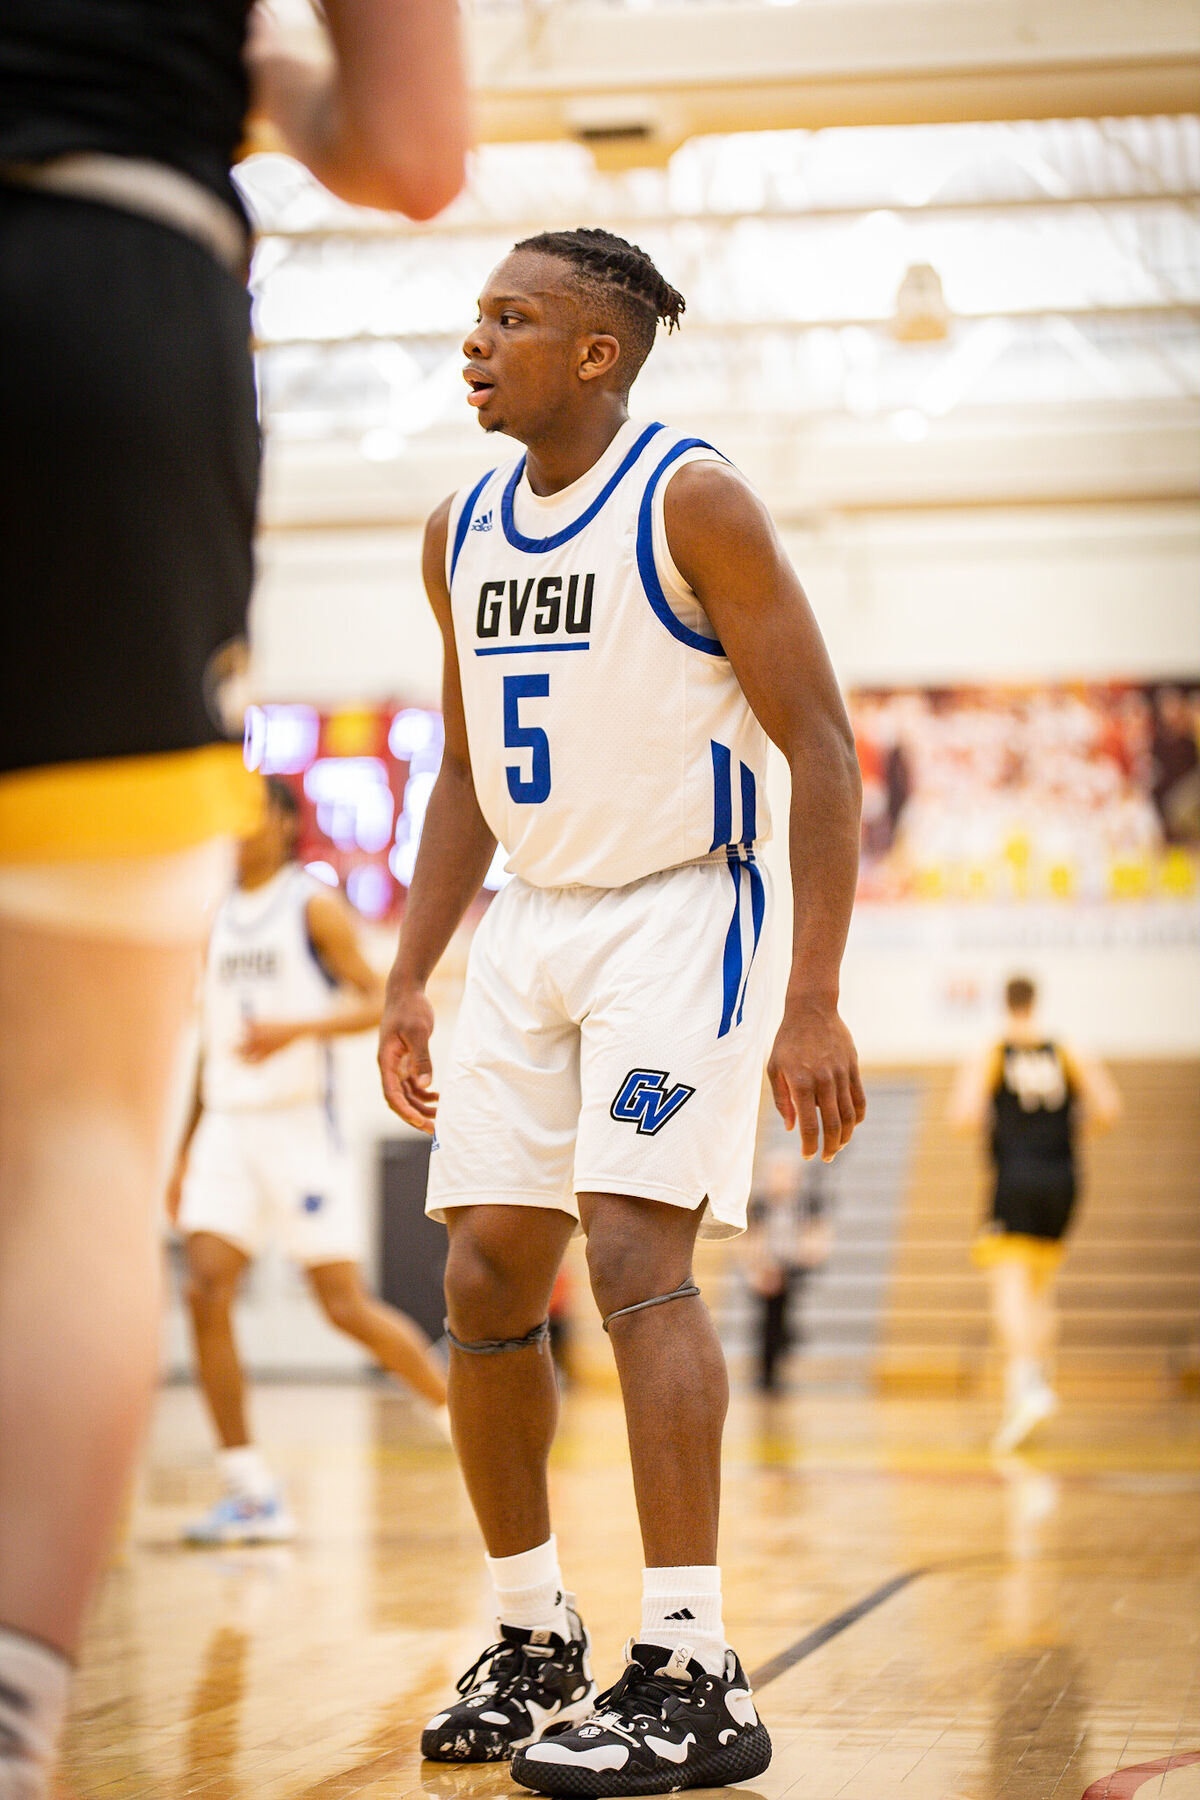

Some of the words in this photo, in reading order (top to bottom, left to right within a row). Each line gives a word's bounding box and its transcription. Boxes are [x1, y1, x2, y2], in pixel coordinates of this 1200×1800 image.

[476, 573, 595, 638] GVSU
[503, 674, 551, 804] 5
[610, 1068, 696, 1136] GV
